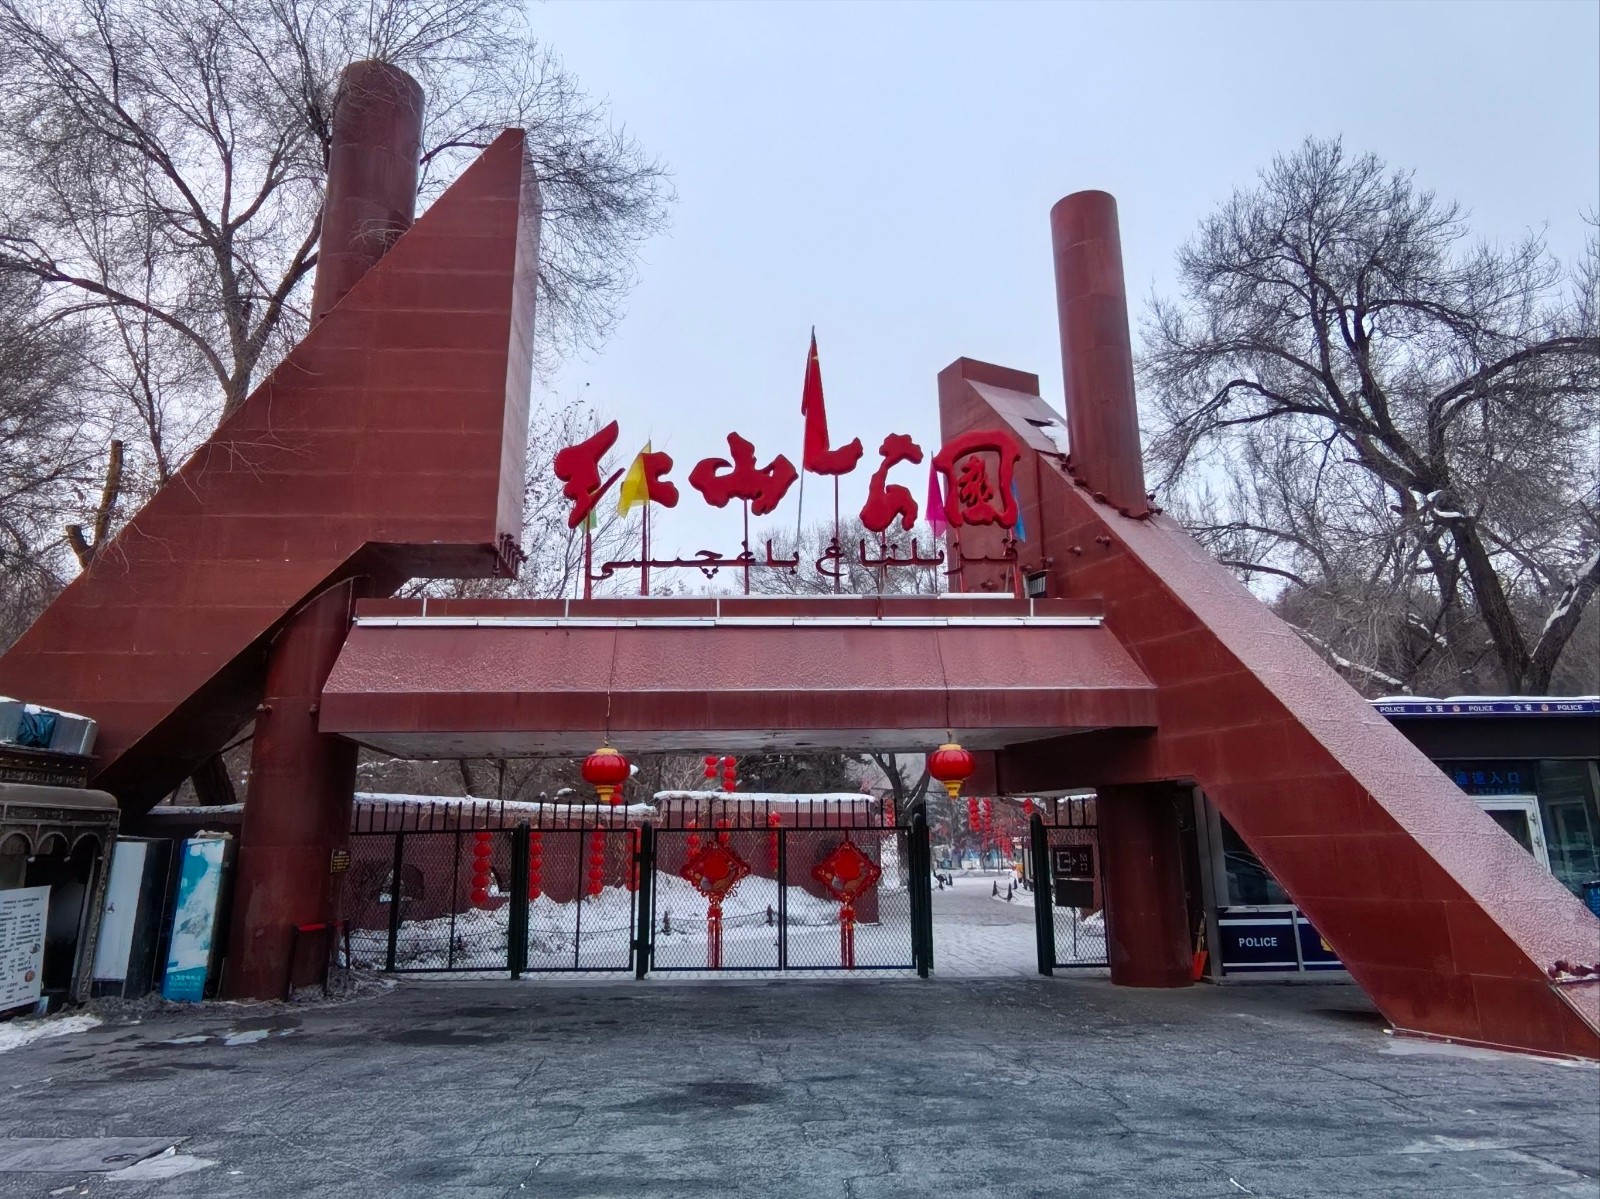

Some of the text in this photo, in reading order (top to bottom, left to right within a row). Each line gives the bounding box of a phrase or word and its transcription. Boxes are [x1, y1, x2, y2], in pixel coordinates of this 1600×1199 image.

[1425, 705, 1444, 713] 公安
[1513, 704, 1533, 712] 公安
[1238, 937, 1278, 947] POLICE
